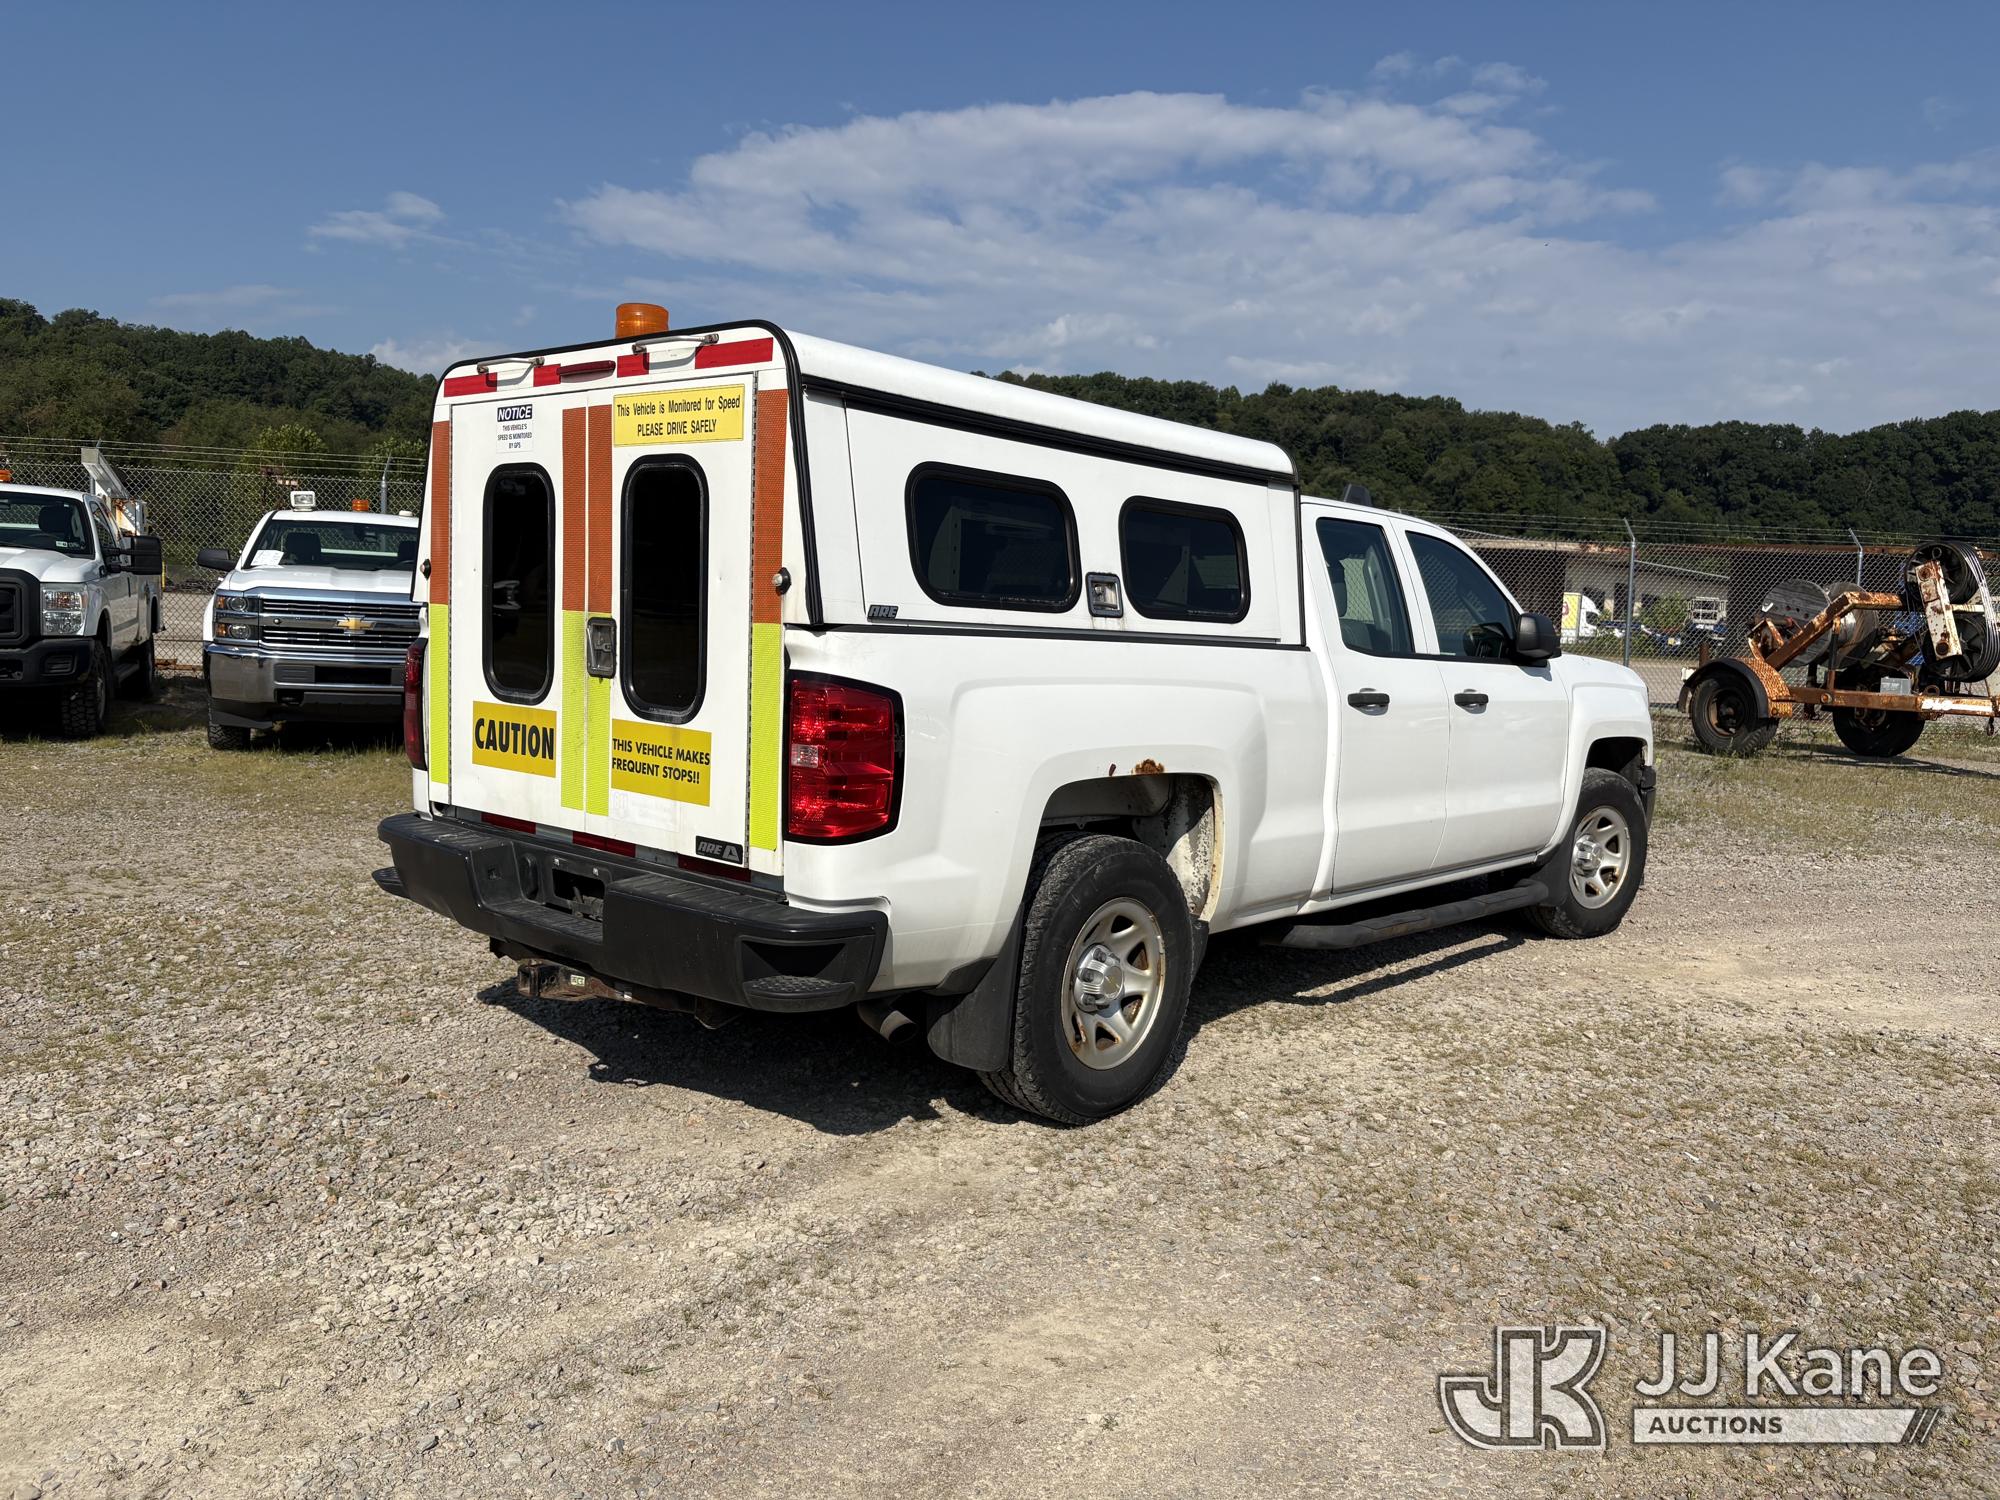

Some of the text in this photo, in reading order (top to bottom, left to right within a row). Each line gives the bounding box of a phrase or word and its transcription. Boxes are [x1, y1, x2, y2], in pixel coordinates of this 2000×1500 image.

[498, 406, 532, 420] NOTICE
[617, 395, 740, 417] This Vehicle is Monitored for Speed
[637, 419, 717, 437] PLEASE DRIVE SAFELY
[868, 605, 898, 618] ARE
[474, 717, 555, 761] CAUTION
[612, 738, 711, 766] THIS VEHICLE MAKES
[612, 757, 700, 785] FREQUENT STOPS!!
